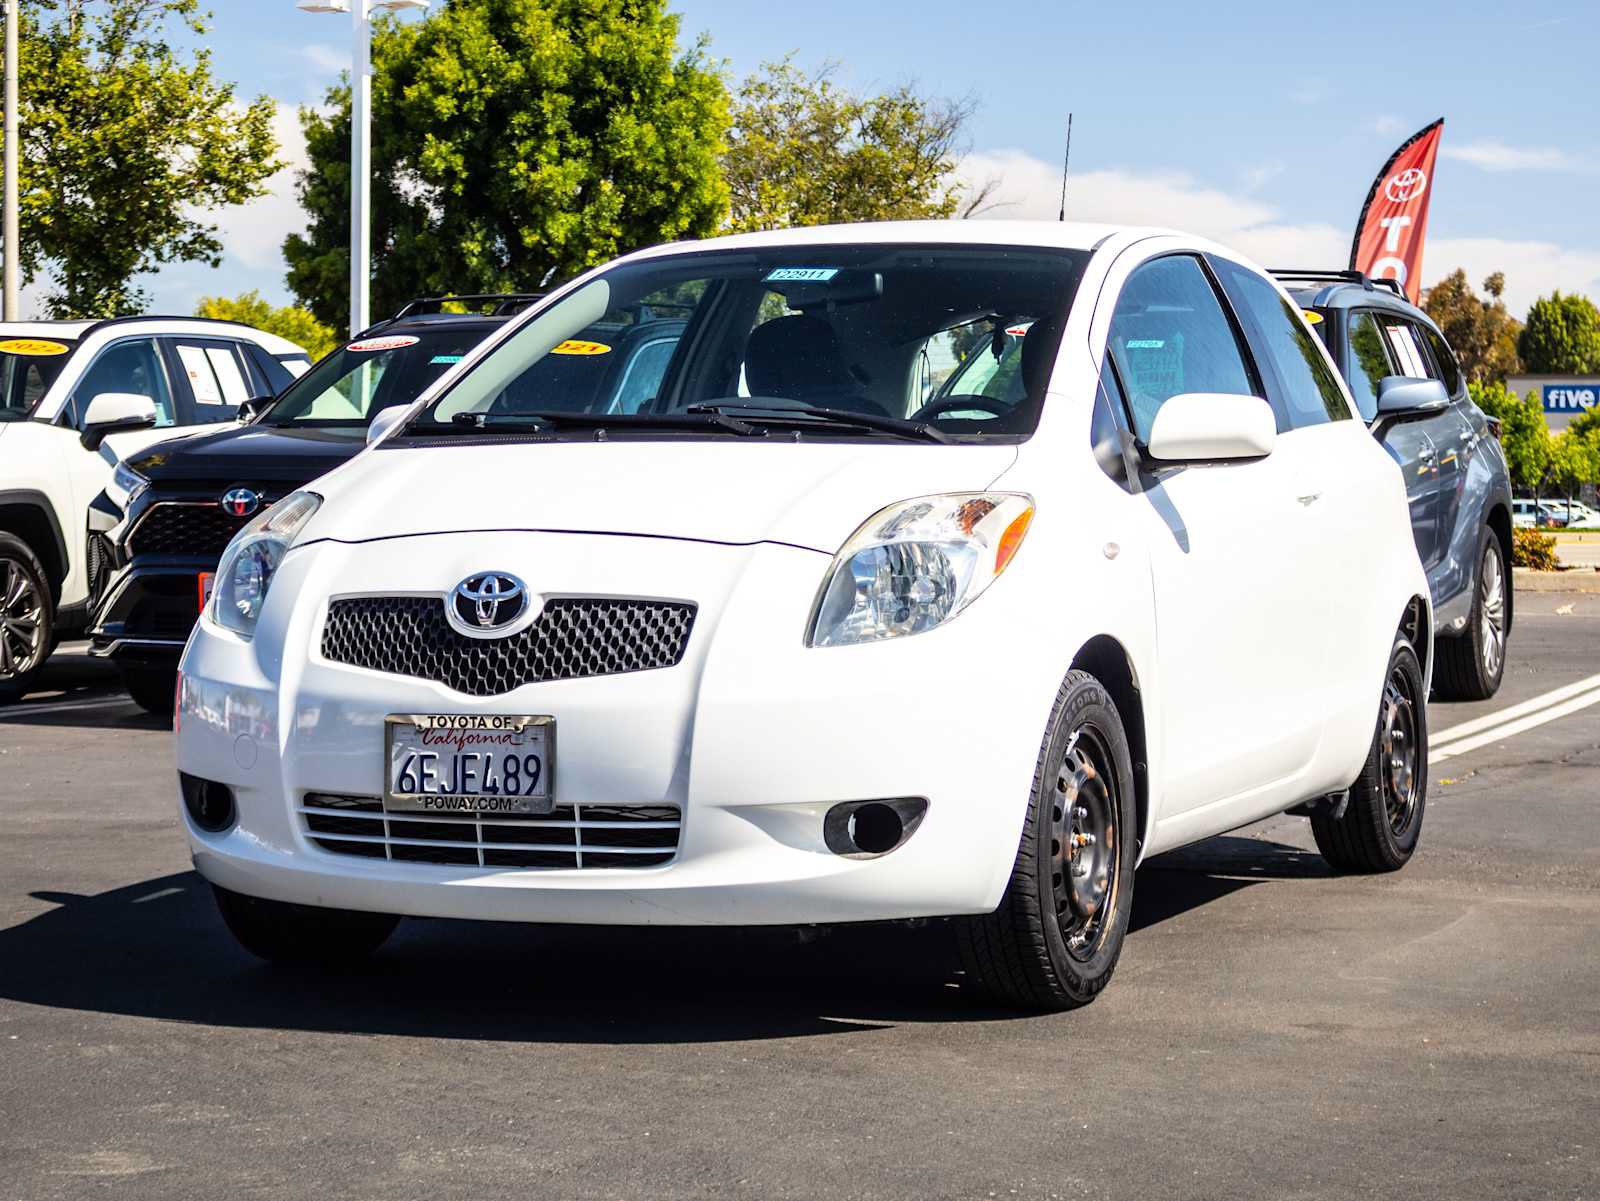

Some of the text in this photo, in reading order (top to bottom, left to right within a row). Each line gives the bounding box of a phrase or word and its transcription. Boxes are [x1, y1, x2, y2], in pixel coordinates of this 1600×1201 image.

[3, 342, 63, 352] 2022
[1548, 389, 1596, 409] five
[428, 715, 512, 729] TOYOTA OF
[422, 728, 524, 751] California
[399, 754, 541, 796] 6EJE489
[424, 796, 513, 811] POWAY.COM
